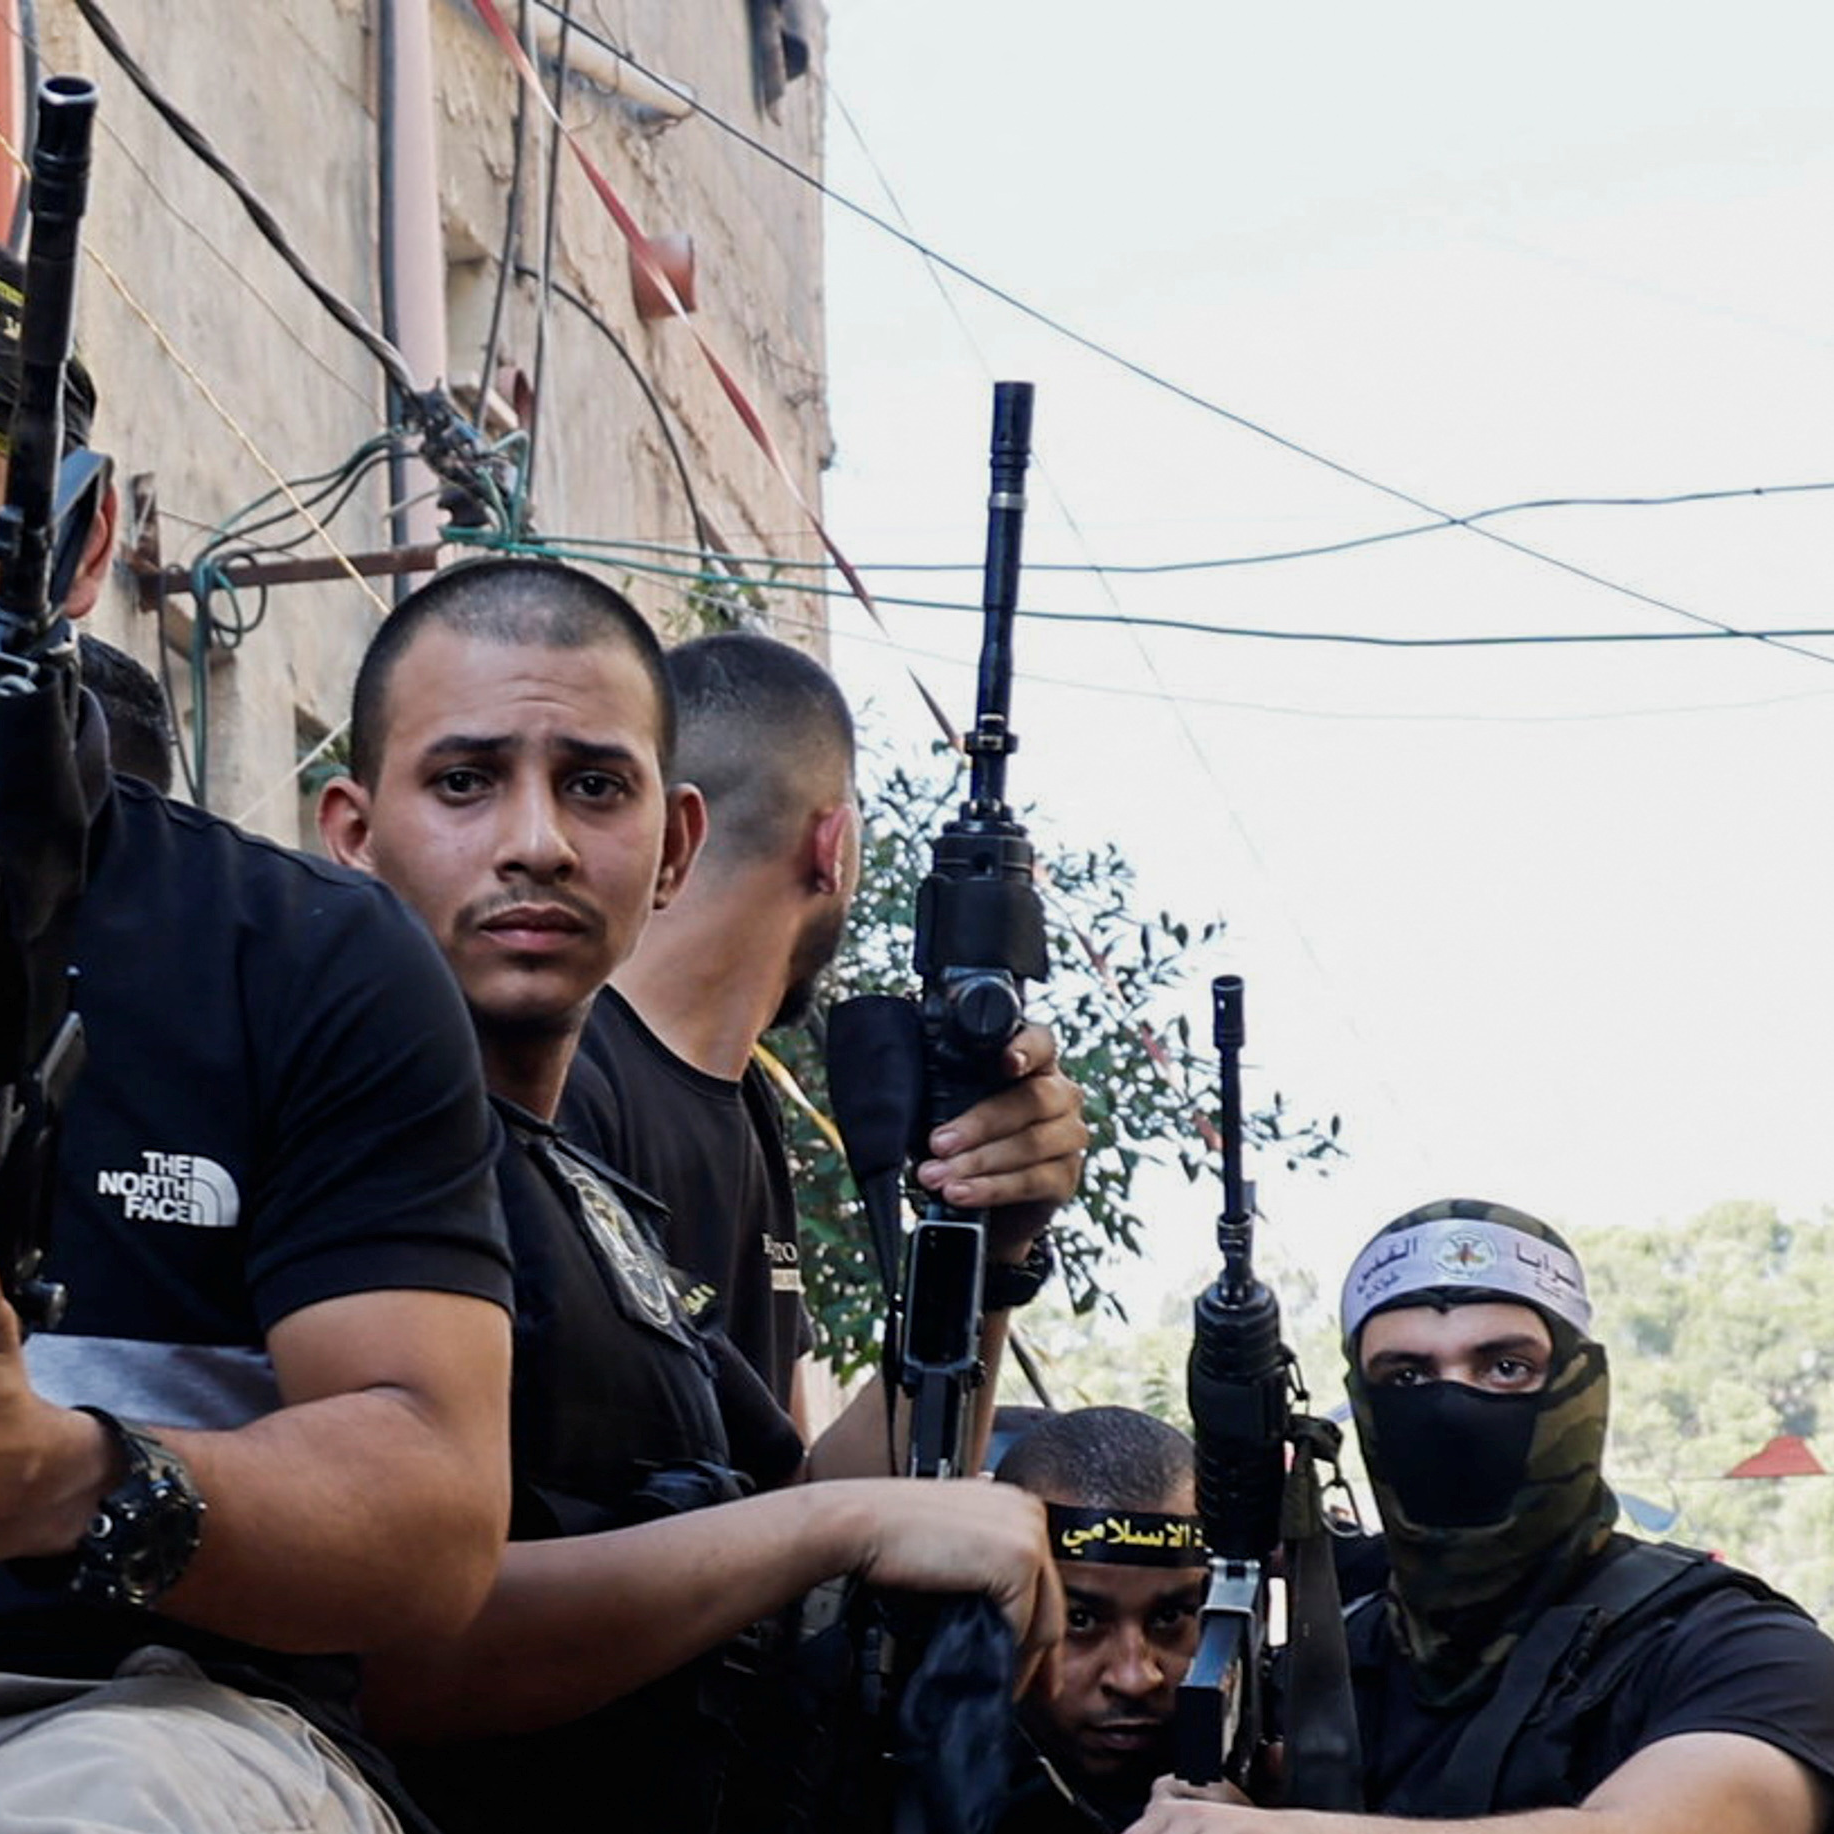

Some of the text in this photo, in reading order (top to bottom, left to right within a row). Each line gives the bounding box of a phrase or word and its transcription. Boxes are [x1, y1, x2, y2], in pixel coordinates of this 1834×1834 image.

[141, 1150, 193, 1178] THE
[97, 1171, 191, 1200] NORTH
[124, 1196, 193, 1224] FACE
